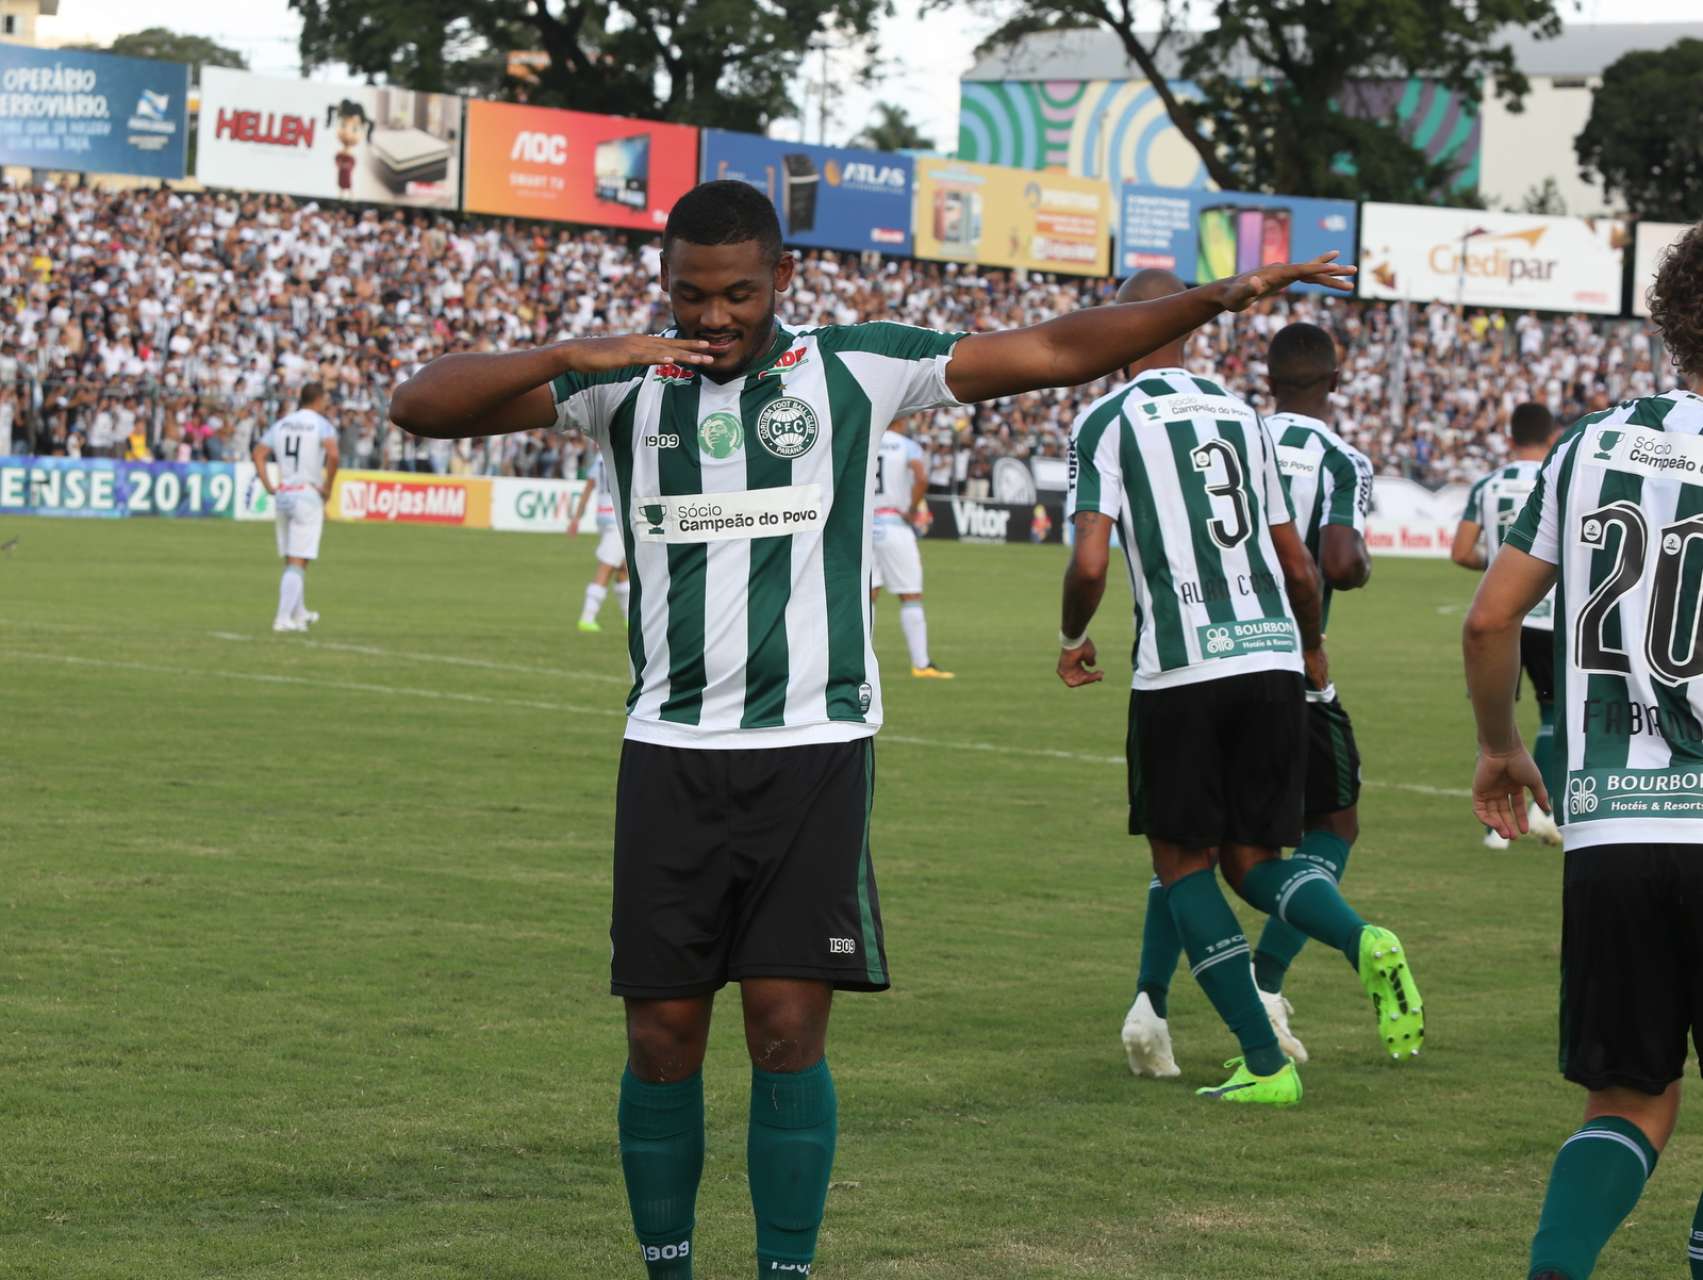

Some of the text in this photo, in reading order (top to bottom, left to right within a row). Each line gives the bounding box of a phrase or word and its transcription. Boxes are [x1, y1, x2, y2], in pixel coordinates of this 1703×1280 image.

[215, 107, 315, 149] HELLEN
[511, 131, 568, 165] AOC
[844, 162, 906, 188] ATLAS
[1427, 244, 1559, 285] Credipar
[285, 435, 301, 473] 4
[644, 433, 681, 448] 1909
[1630, 449, 1696, 472] Campeão
[128, 471, 234, 513] 2019
[367, 483, 466, 519] LojasMM
[1190, 437, 1252, 549] 3
[677, 503, 723, 519] Sócio
[679, 509, 818, 533] Campeão do Povo
[952, 499, 1011, 537] Vitor
[1574, 500, 1703, 688] 20
[1235, 622, 1293, 637] BOURBON
[1651, 801, 1660, 811] &
[829, 937, 856, 954] 1909
[640, 1240, 690, 1261] 1909
